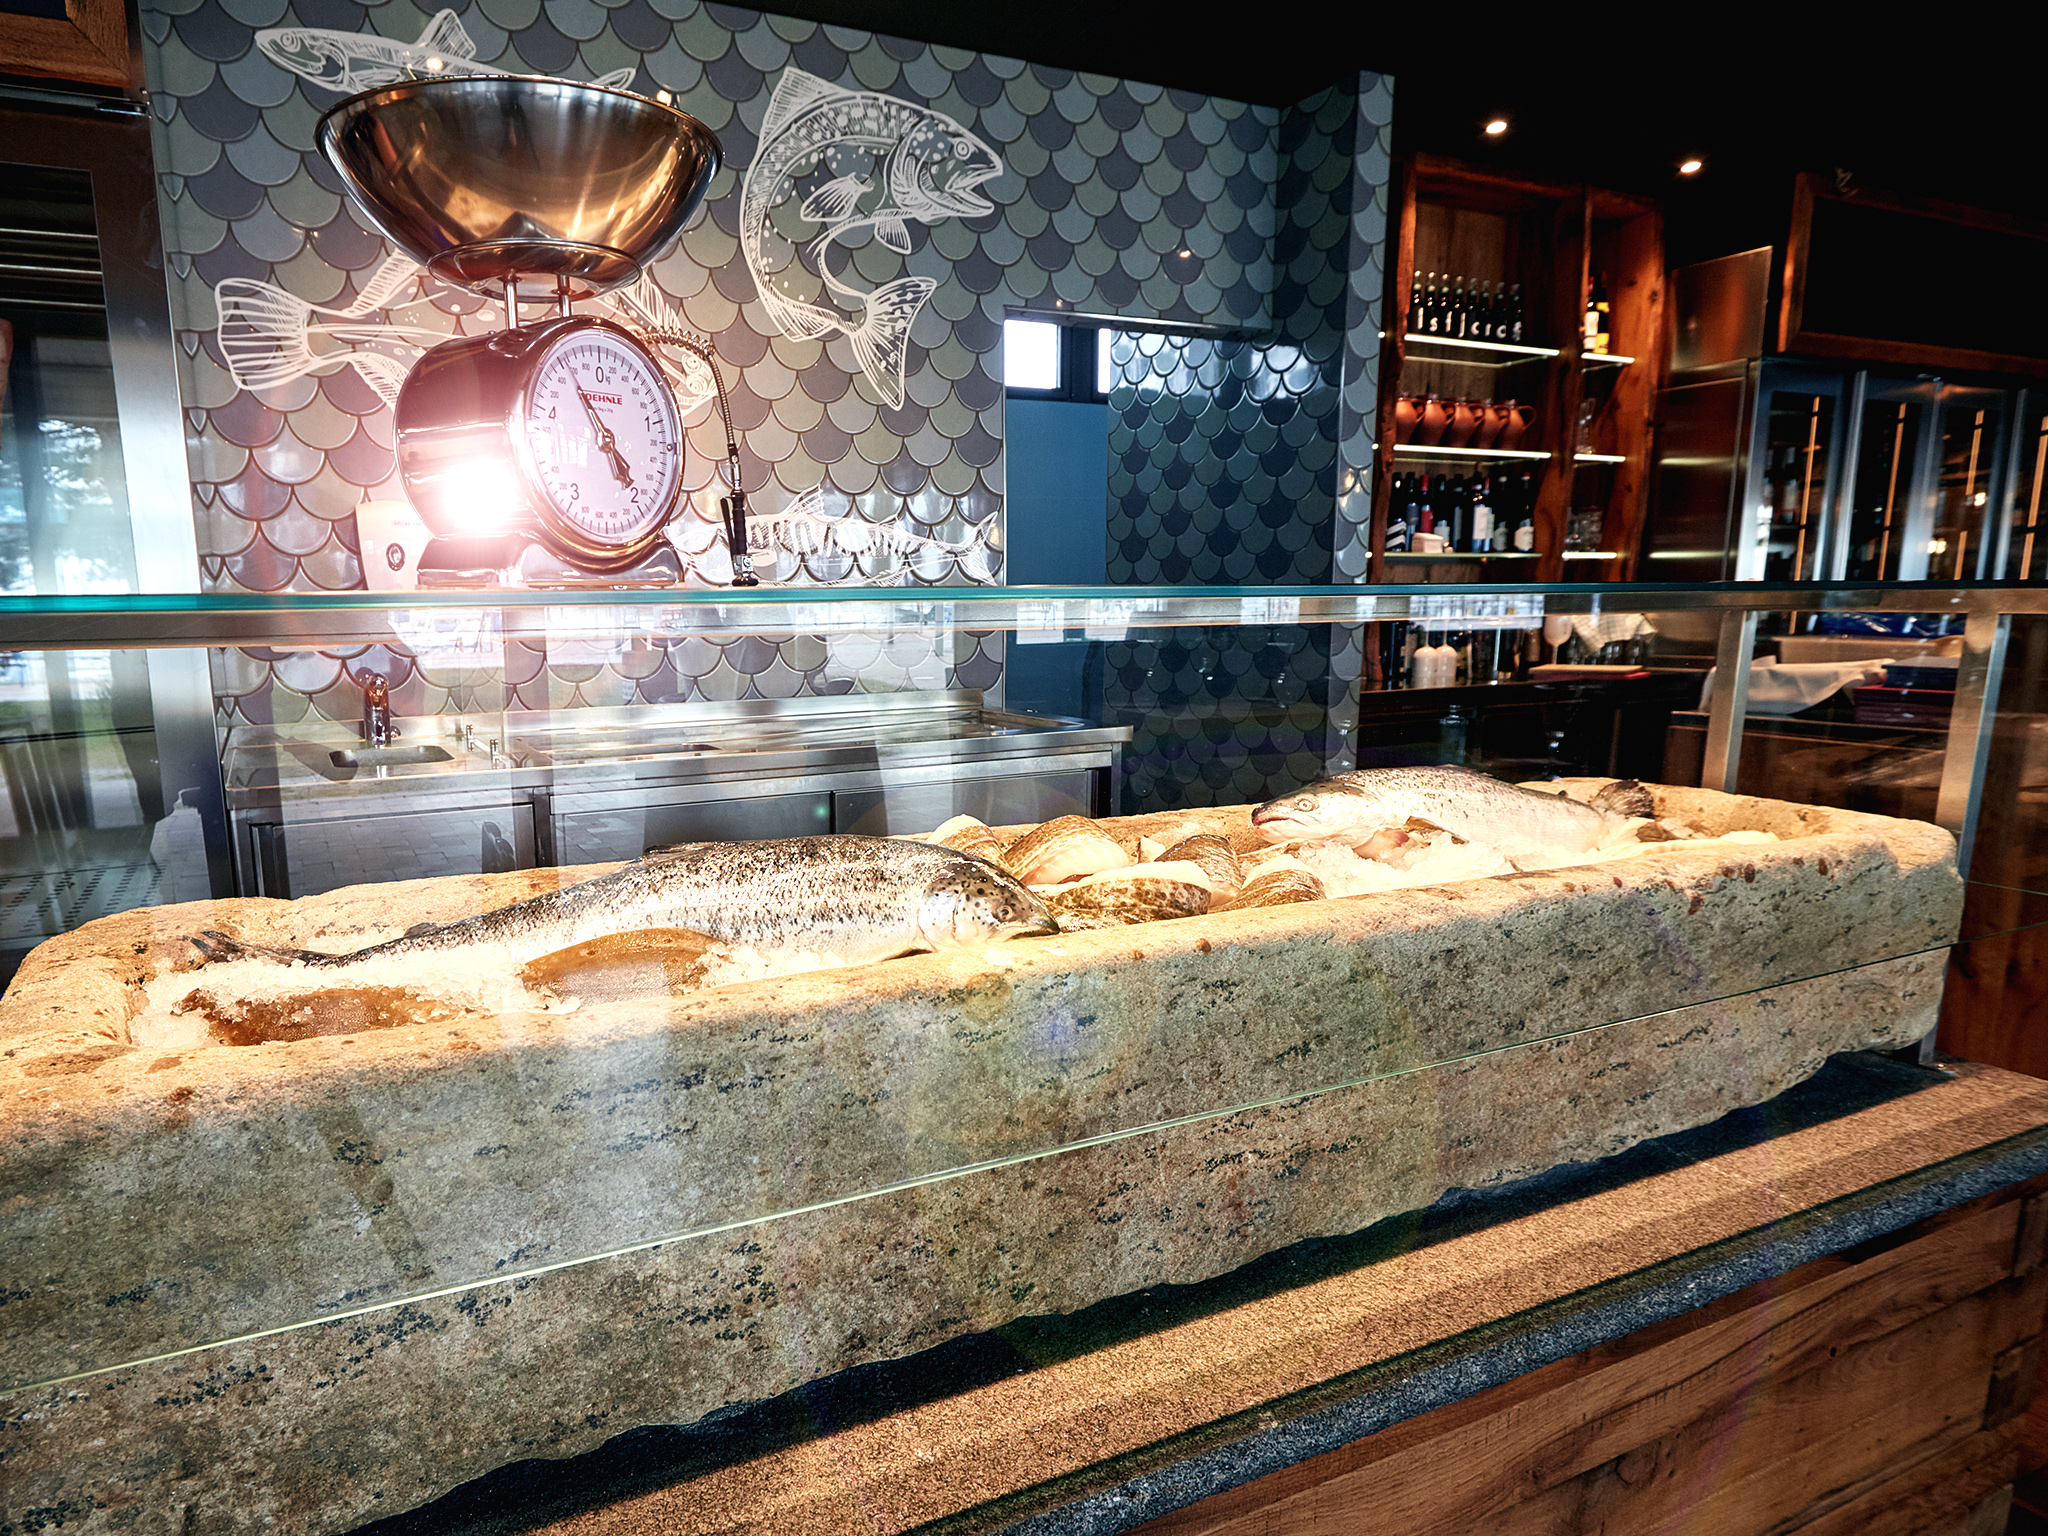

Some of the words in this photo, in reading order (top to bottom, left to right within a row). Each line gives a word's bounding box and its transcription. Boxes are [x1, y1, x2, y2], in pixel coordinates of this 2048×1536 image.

[595, 366, 604, 383] 0
[583, 392, 623, 405] OEHNLE
[548, 405, 557, 420] 4
[644, 415, 650, 432] 1
[570, 483, 580, 501] 3
[630, 486, 639, 503] 2
